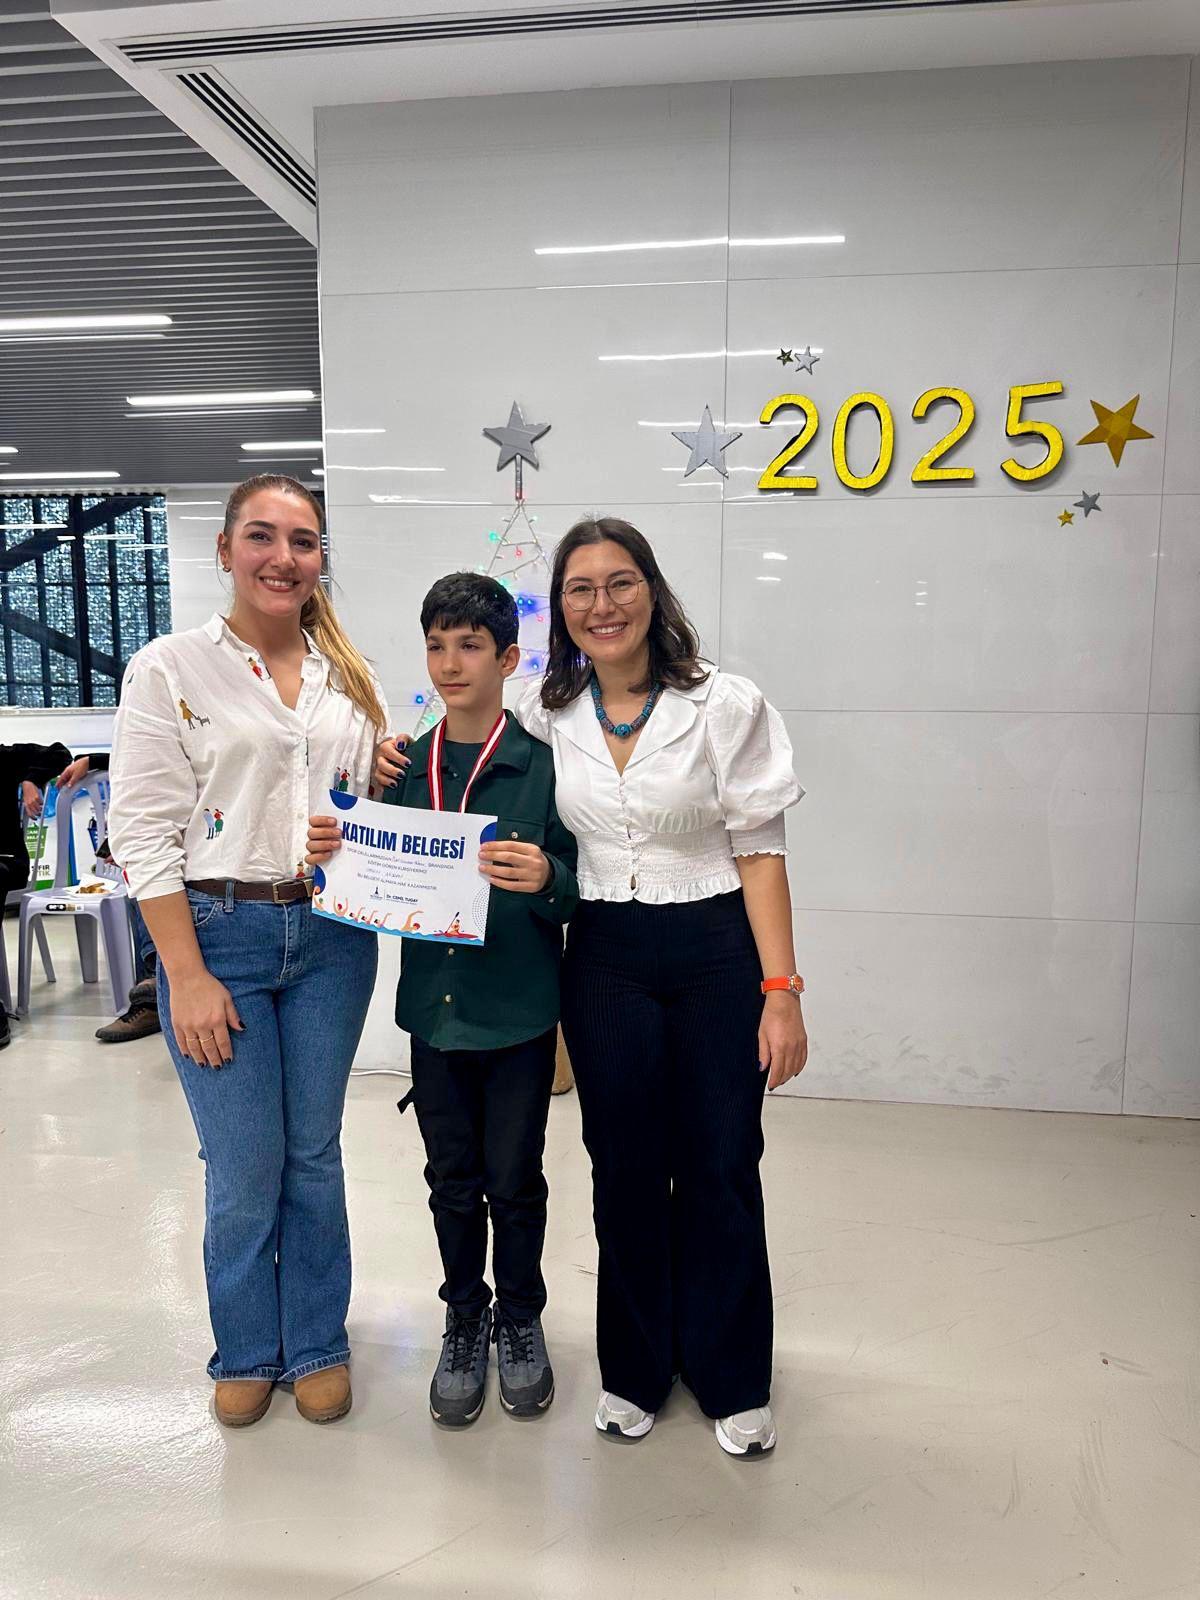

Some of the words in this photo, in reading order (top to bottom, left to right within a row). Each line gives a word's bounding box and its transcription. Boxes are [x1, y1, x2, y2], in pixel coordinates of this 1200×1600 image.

[758, 381, 1064, 489] 2025
[342, 821, 397, 852] KATILIM
[401, 835, 466, 860] BELGESİ
